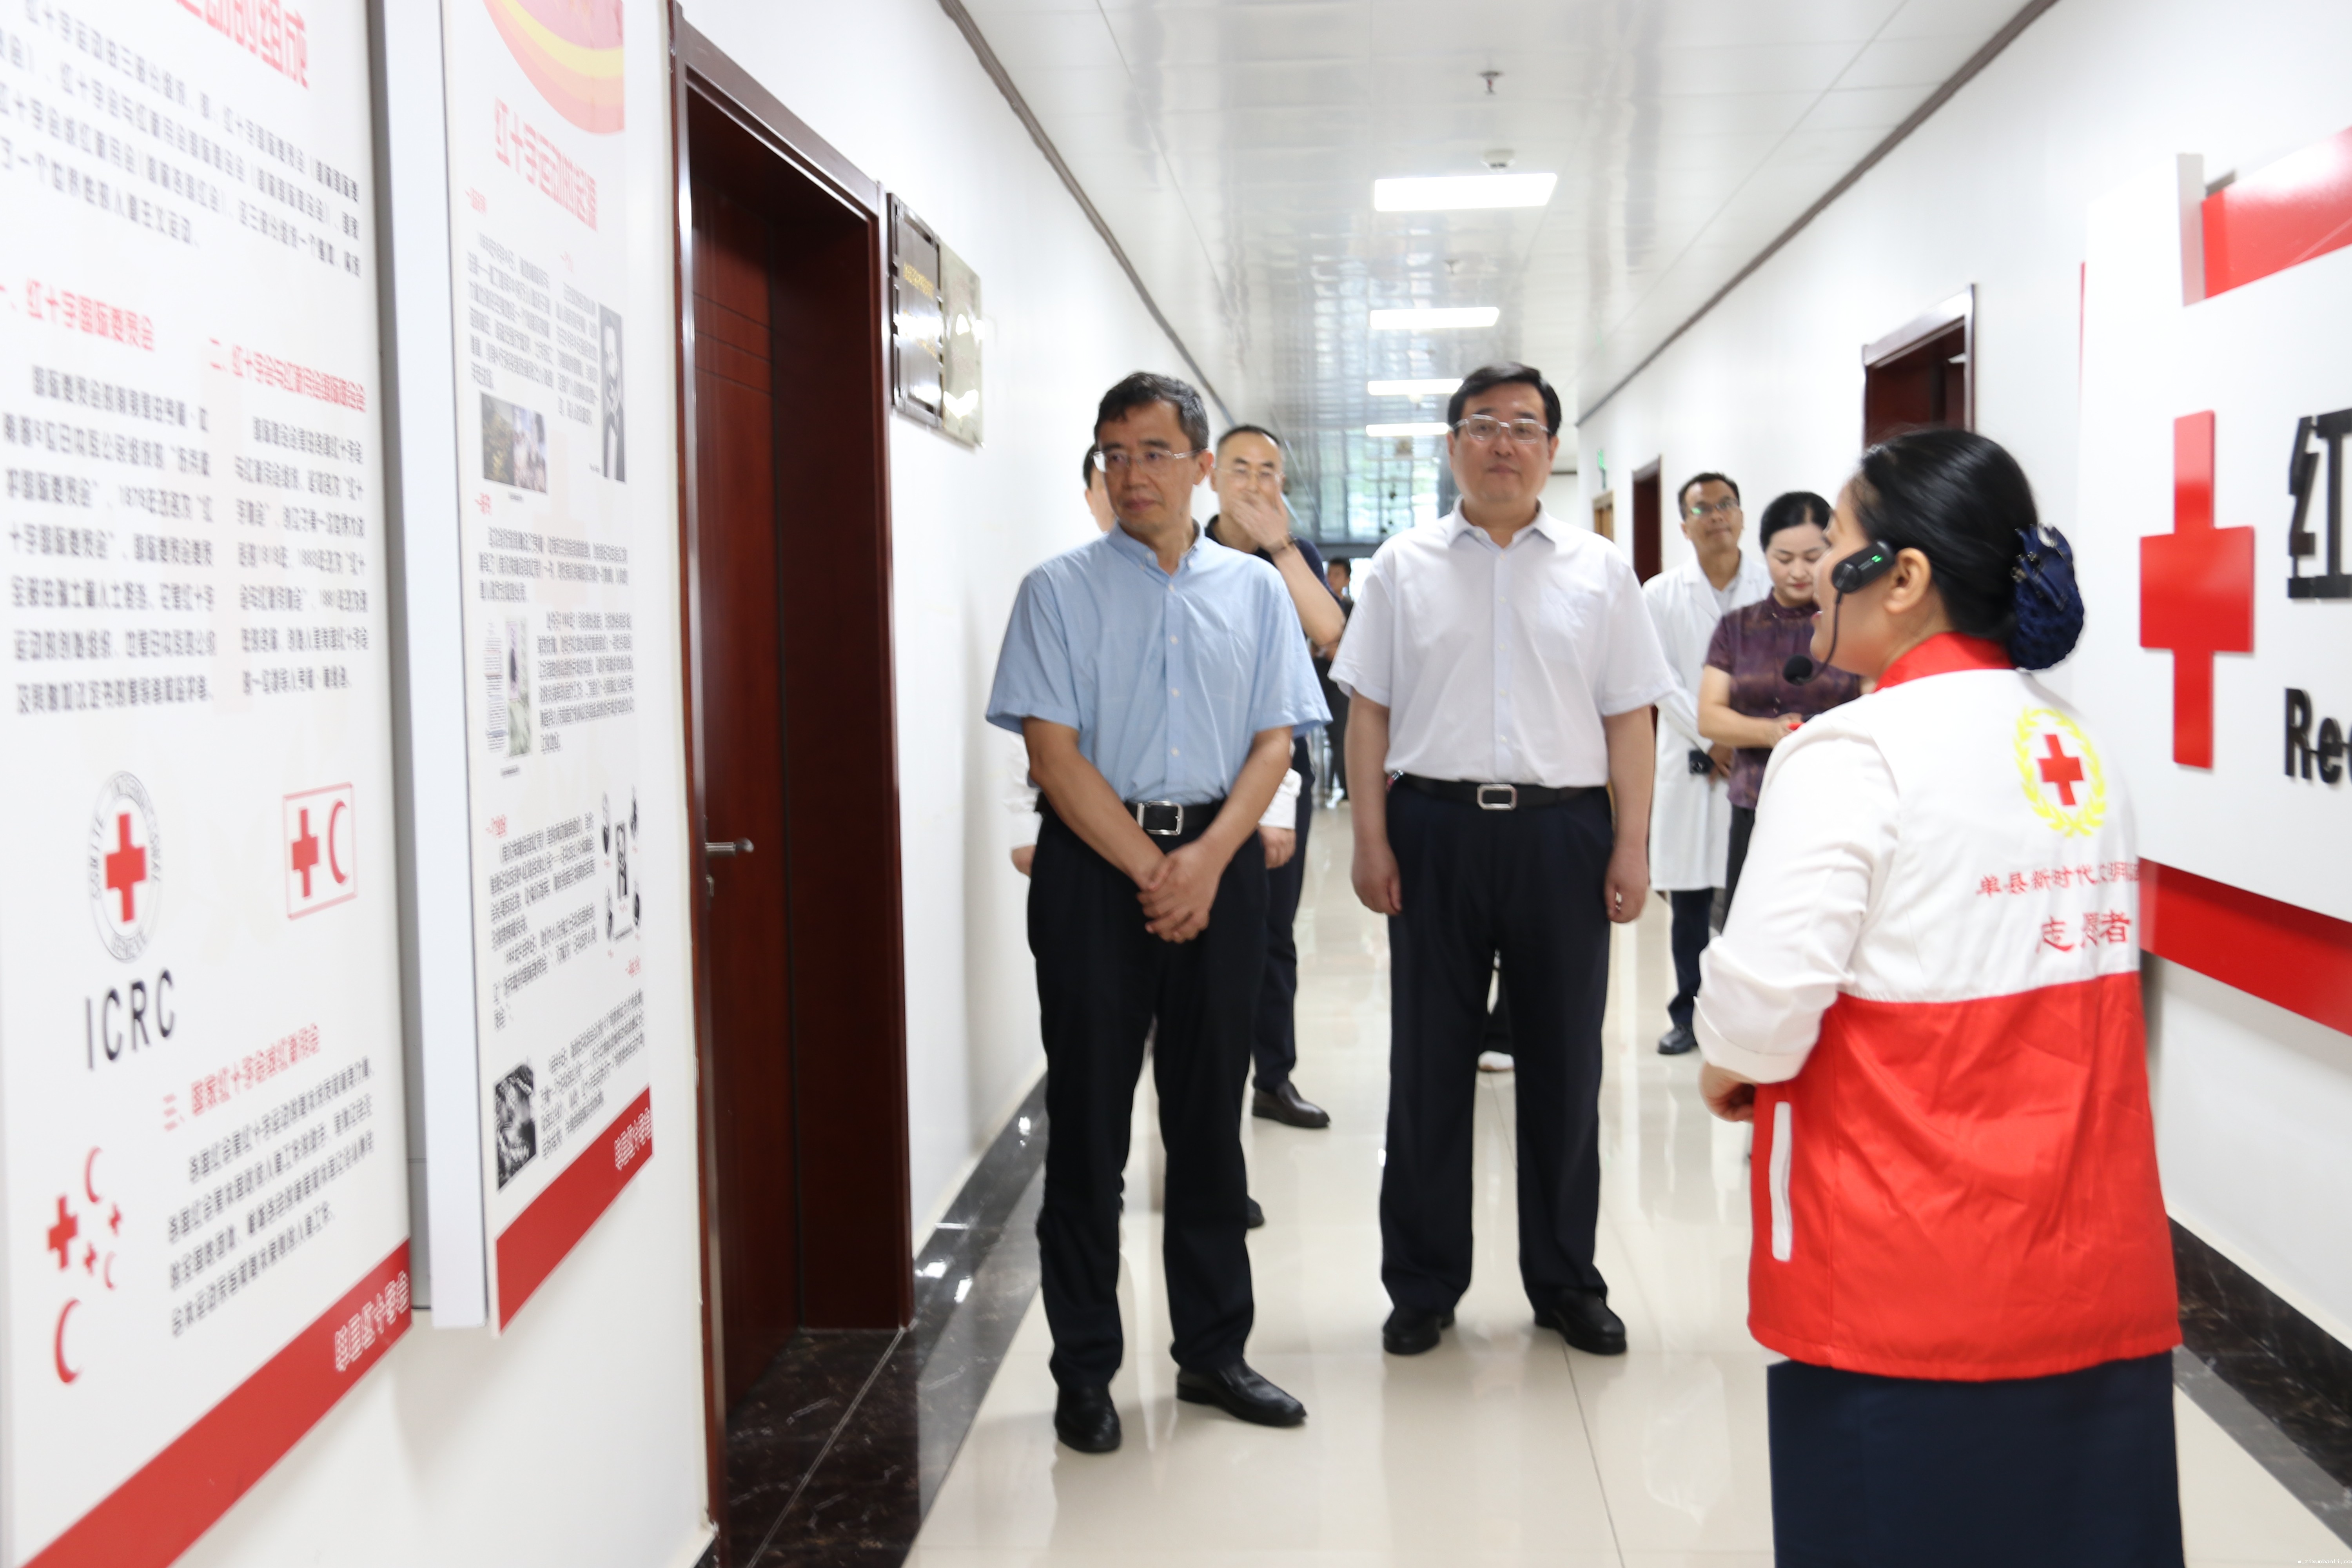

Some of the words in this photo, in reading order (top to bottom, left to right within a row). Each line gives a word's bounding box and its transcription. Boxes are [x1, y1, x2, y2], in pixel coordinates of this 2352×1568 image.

[175, 0, 309, 90] 的组成
[2287, 408, 2352, 599] 红
[2285, 687, 2352, 784] Re
[85, 966, 174, 1071] ICRC
